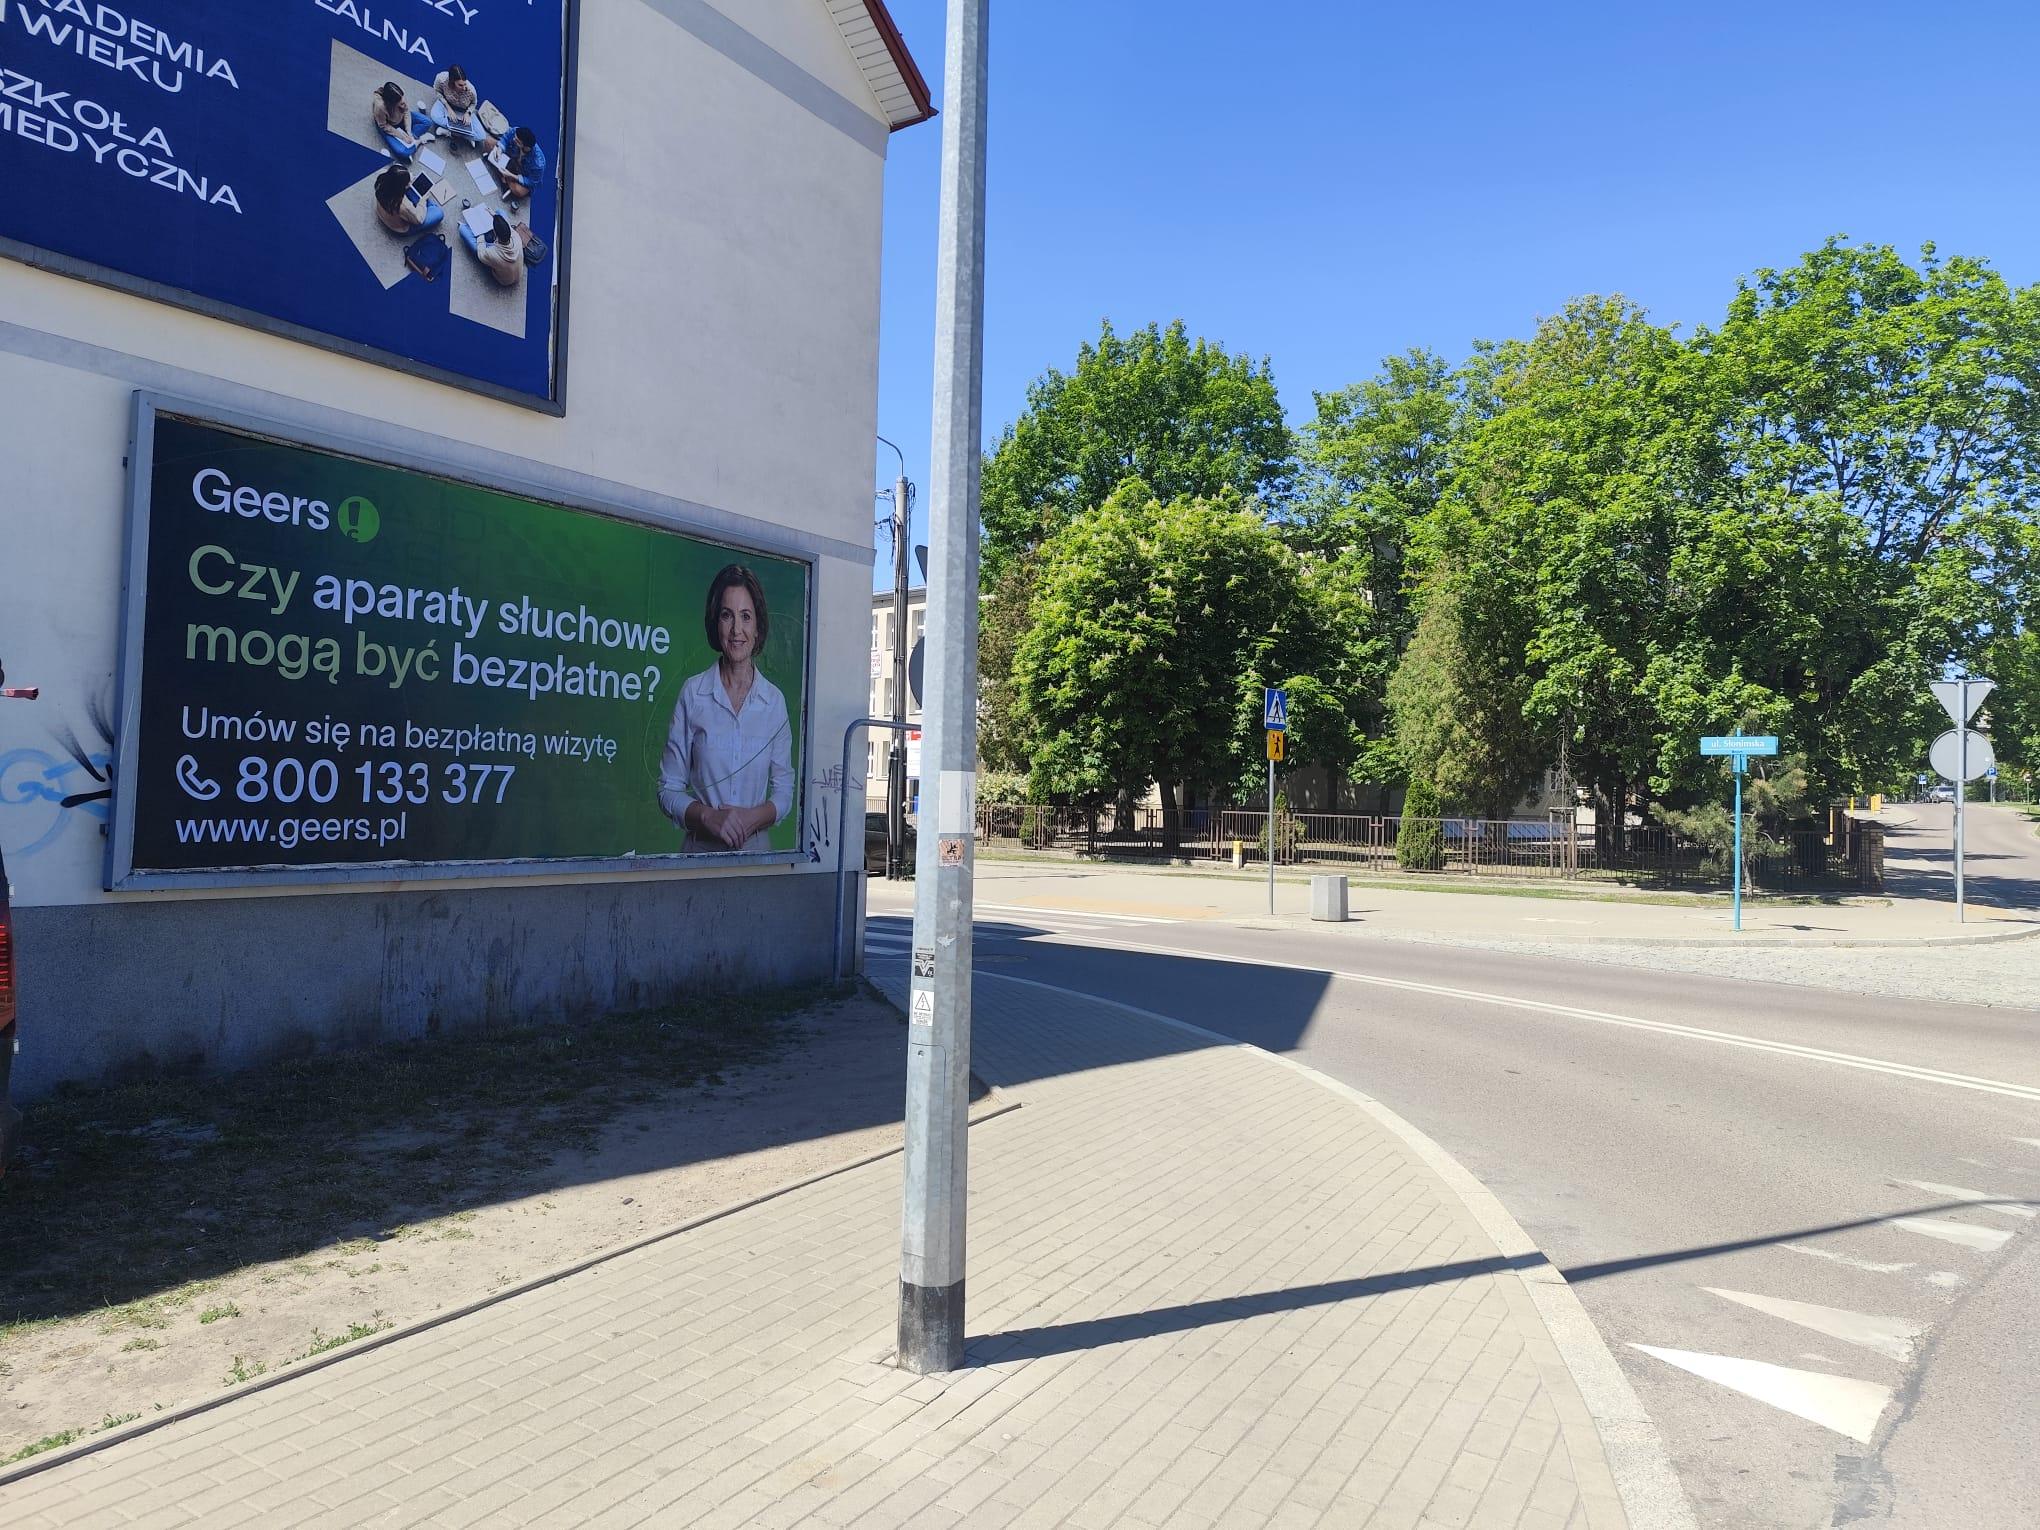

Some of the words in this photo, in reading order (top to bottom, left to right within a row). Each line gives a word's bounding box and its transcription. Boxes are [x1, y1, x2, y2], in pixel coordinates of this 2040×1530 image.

[17, 2, 184, 93] WIEKU
[38, 0, 239, 90] ADEMIA
[0, 67, 175, 158] ZKOŁA
[192, 467, 330, 531] Geers
[188, 544, 300, 615] Czy
[312, 574, 489, 639] aparaty
[497, 595, 671, 654] słuchowe
[185, 623, 341, 685] mogą
[356, 630, 441, 689] być
[452, 641, 661, 702] bezpłatne?
[181, 705, 297, 743] Umów
[305, 714, 351, 753] się
[359, 723, 396, 748] na
[404, 719, 537, 760] bezpłatną
[543, 729, 618, 764] wizytę
[1723, 738, 1765, 749] Słonimska
[235, 756, 340, 804] 800
[354, 760, 430, 805] 133
[441, 762, 516, 805] 377
[175, 811, 408, 849] www.geers.pl
